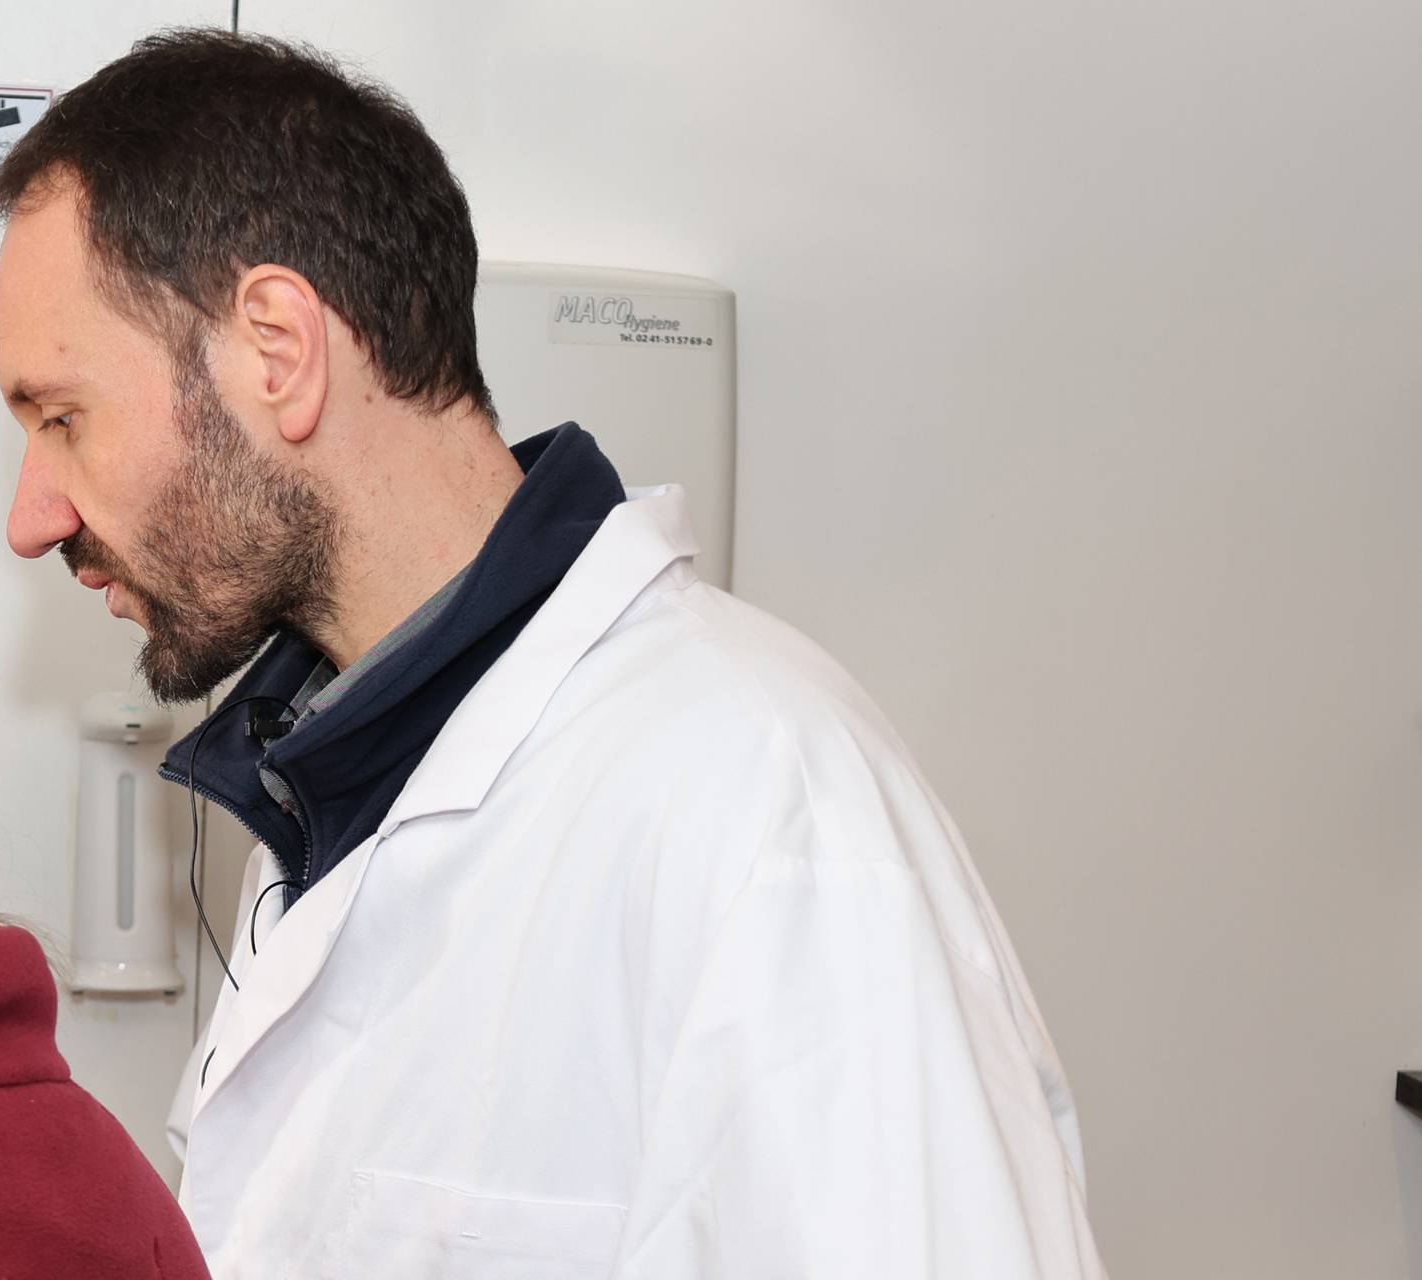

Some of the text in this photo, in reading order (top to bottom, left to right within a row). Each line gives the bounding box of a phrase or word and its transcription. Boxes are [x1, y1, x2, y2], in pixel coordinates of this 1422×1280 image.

[554, 296, 633, 325] MACO
[624, 314, 680, 333] Hygiene
[620, 333, 633, 342] Tel.
